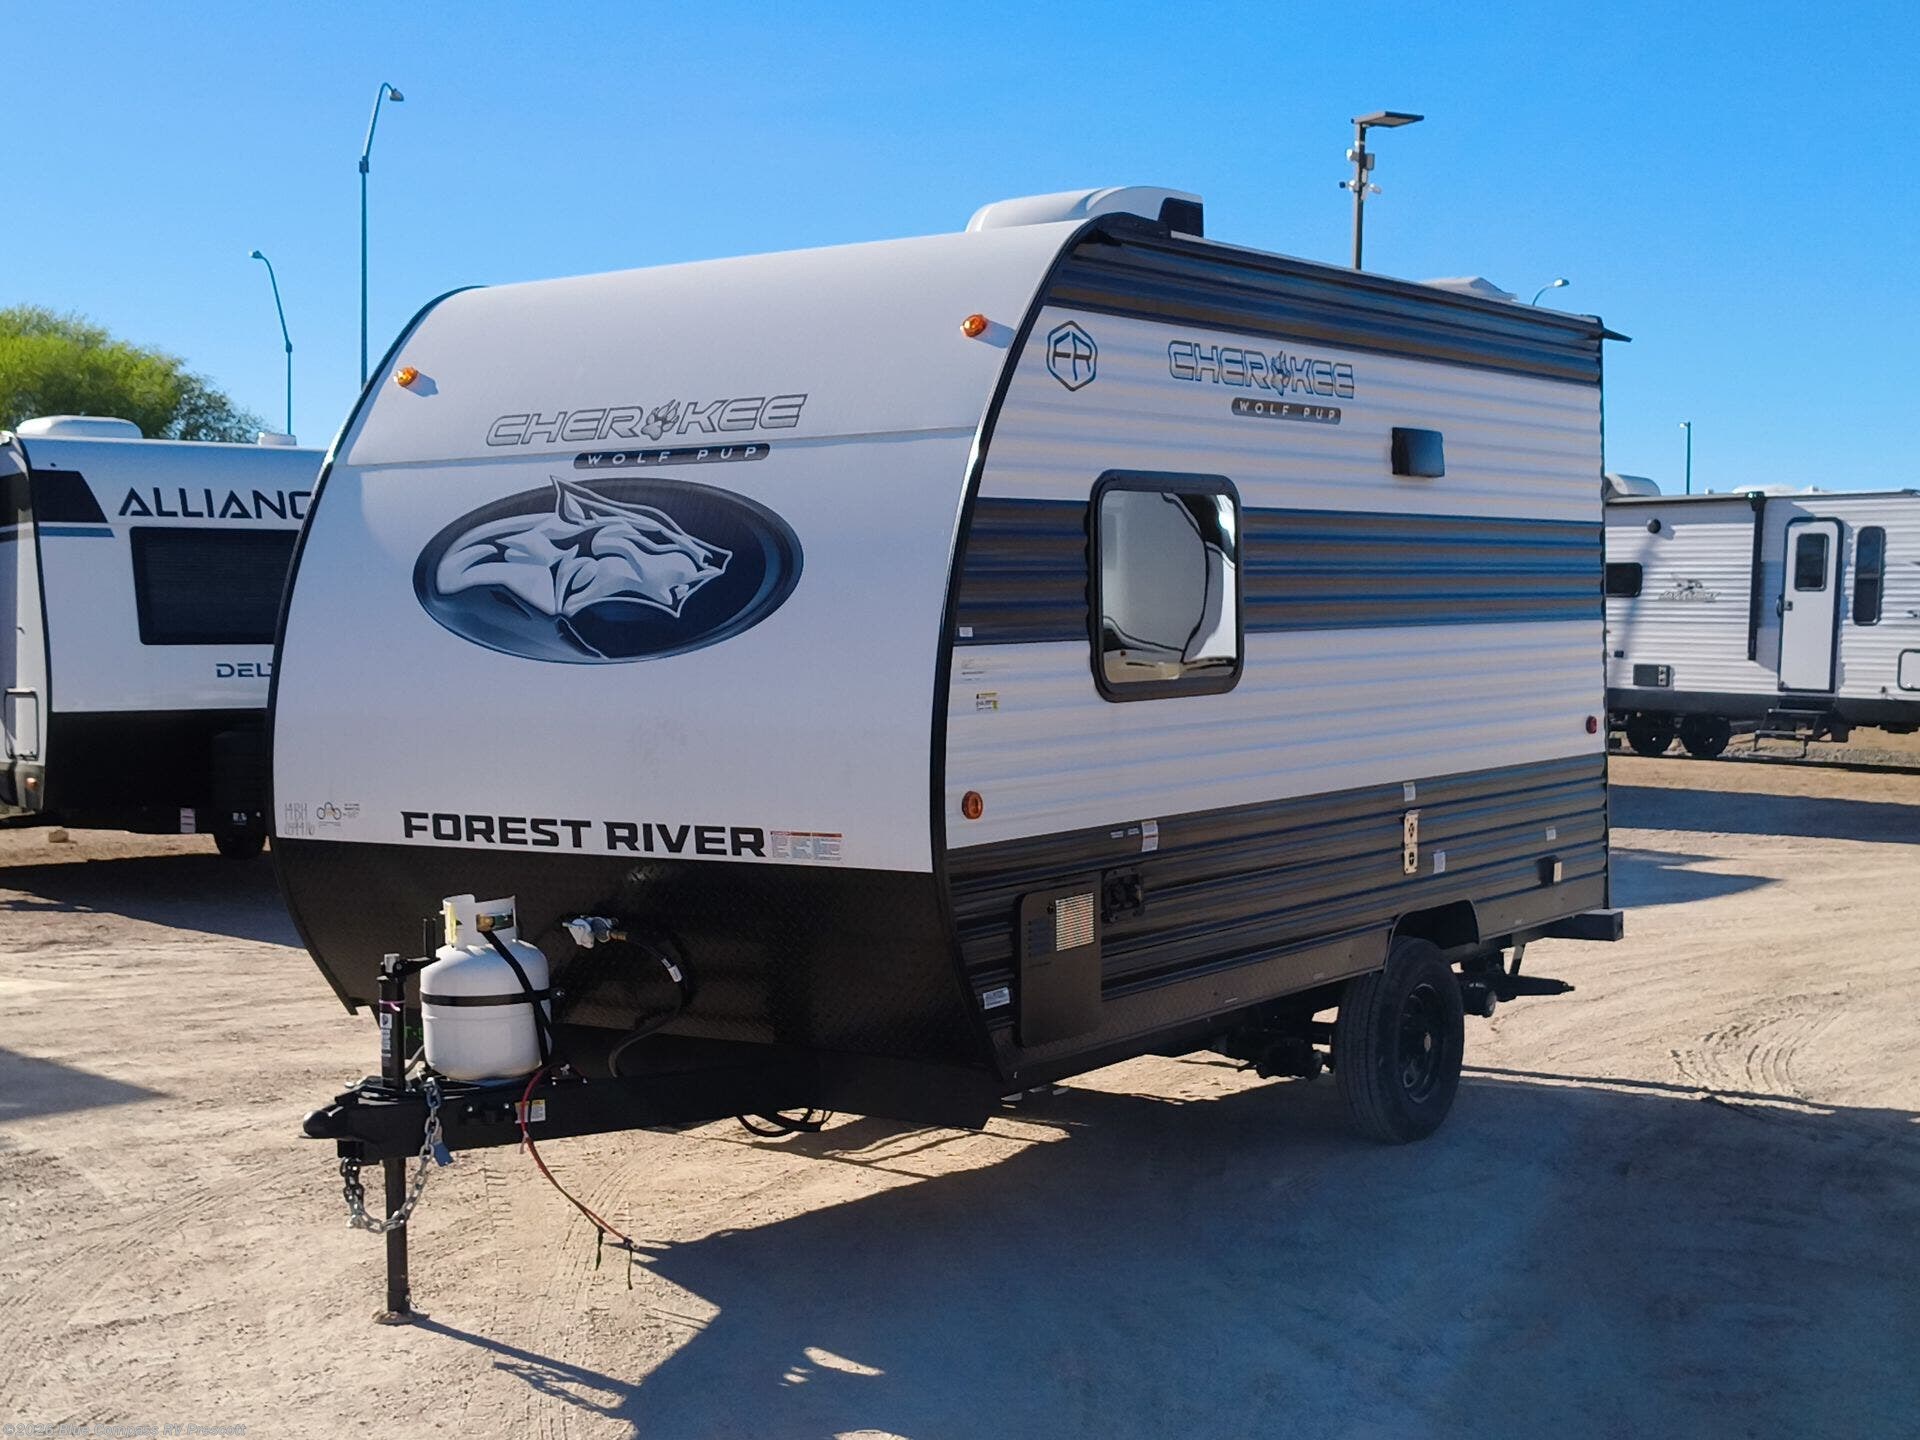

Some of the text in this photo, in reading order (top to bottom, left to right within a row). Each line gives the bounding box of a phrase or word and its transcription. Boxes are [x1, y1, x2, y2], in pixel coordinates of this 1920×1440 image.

[1239, 400, 1337, 421] WOLF PUP
[586, 445, 759, 465] WOLF PUP
[402, 811, 591, 848] FOREST
[603, 821, 765, 857] RIVER
